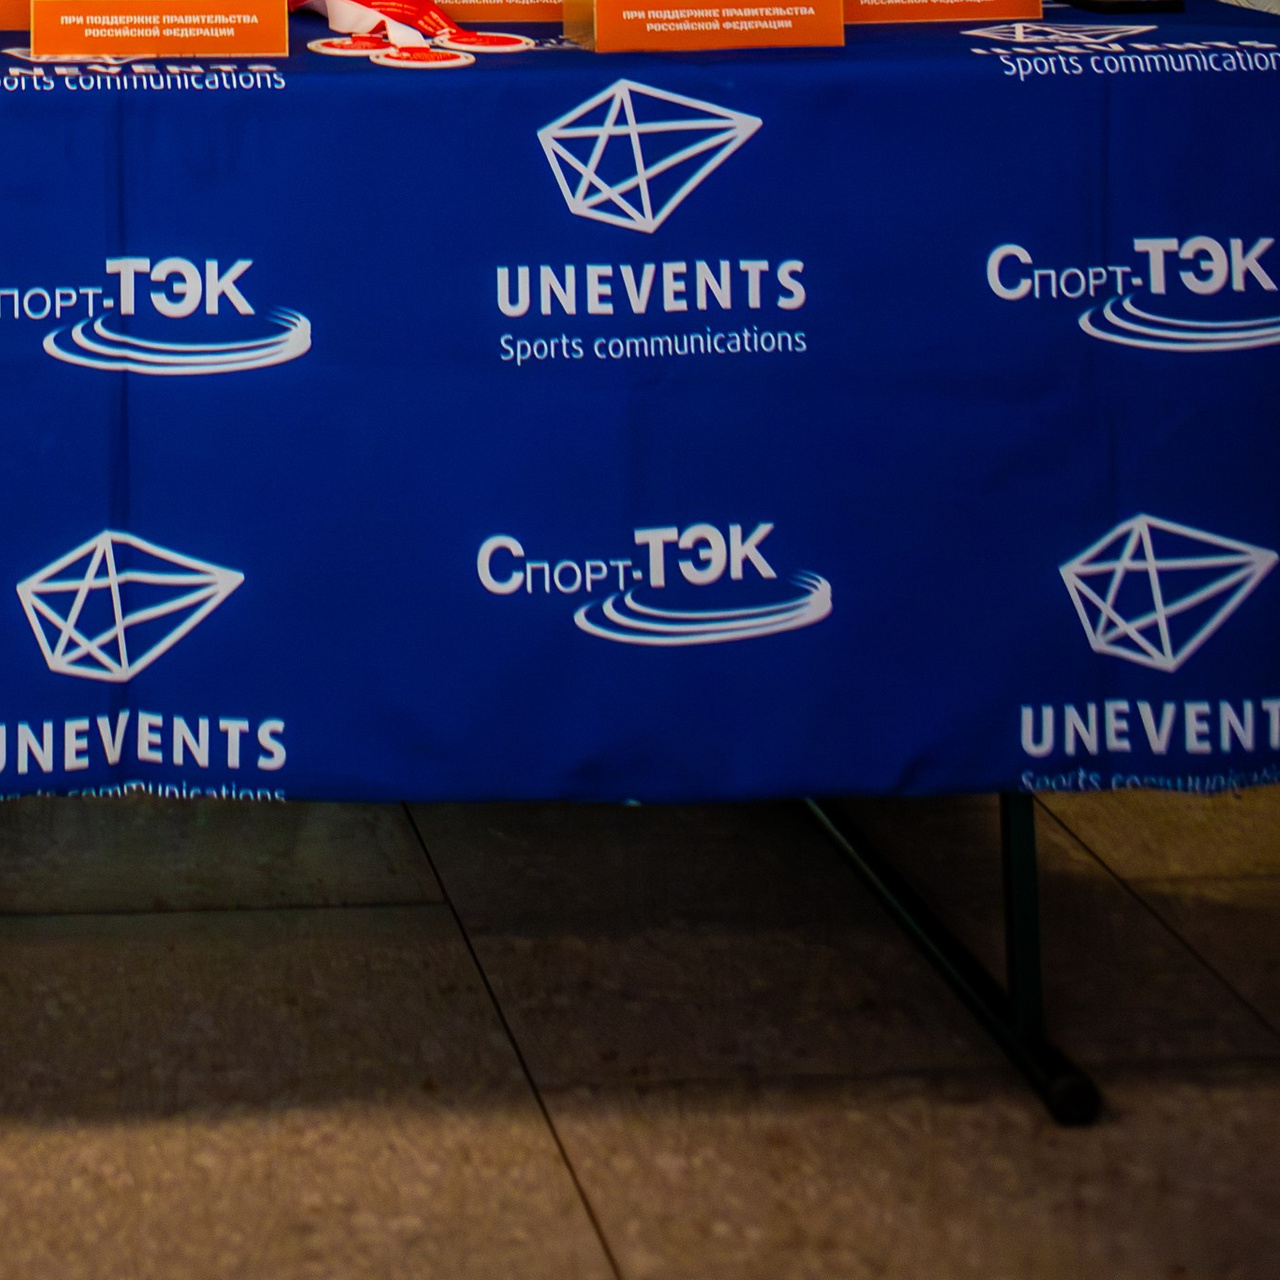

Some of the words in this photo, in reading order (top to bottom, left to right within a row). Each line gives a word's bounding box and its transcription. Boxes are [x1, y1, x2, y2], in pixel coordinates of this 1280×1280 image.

[60, 14, 84, 25] ПРИ
[86, 14, 160, 26] ПОДДЕРЖКЕ
[162, 14, 259, 25] ПРАВИТЕЛЬСТВА
[622, 9, 646, 20] ПРИ
[647, 8, 720, 20] ПОДДЕРЖКЕ
[722, 6, 816, 18] ПРАВИТЕЛЬСТВА
[84, 26, 160, 38] РОССИЙСКОЙ
[162, 27, 235, 38] ФЕДЕРАЦИИ
[646, 19, 720, 32] РОССИЙСКОЙ
[722, 19, 793, 31] ФЕДЕРАЦИИ
[999, 51, 1084, 82] Sports
[495, 258, 808, 318] UNEVENTS
[499, 332, 584, 365] Sports
[593, 324, 808, 359] communications
